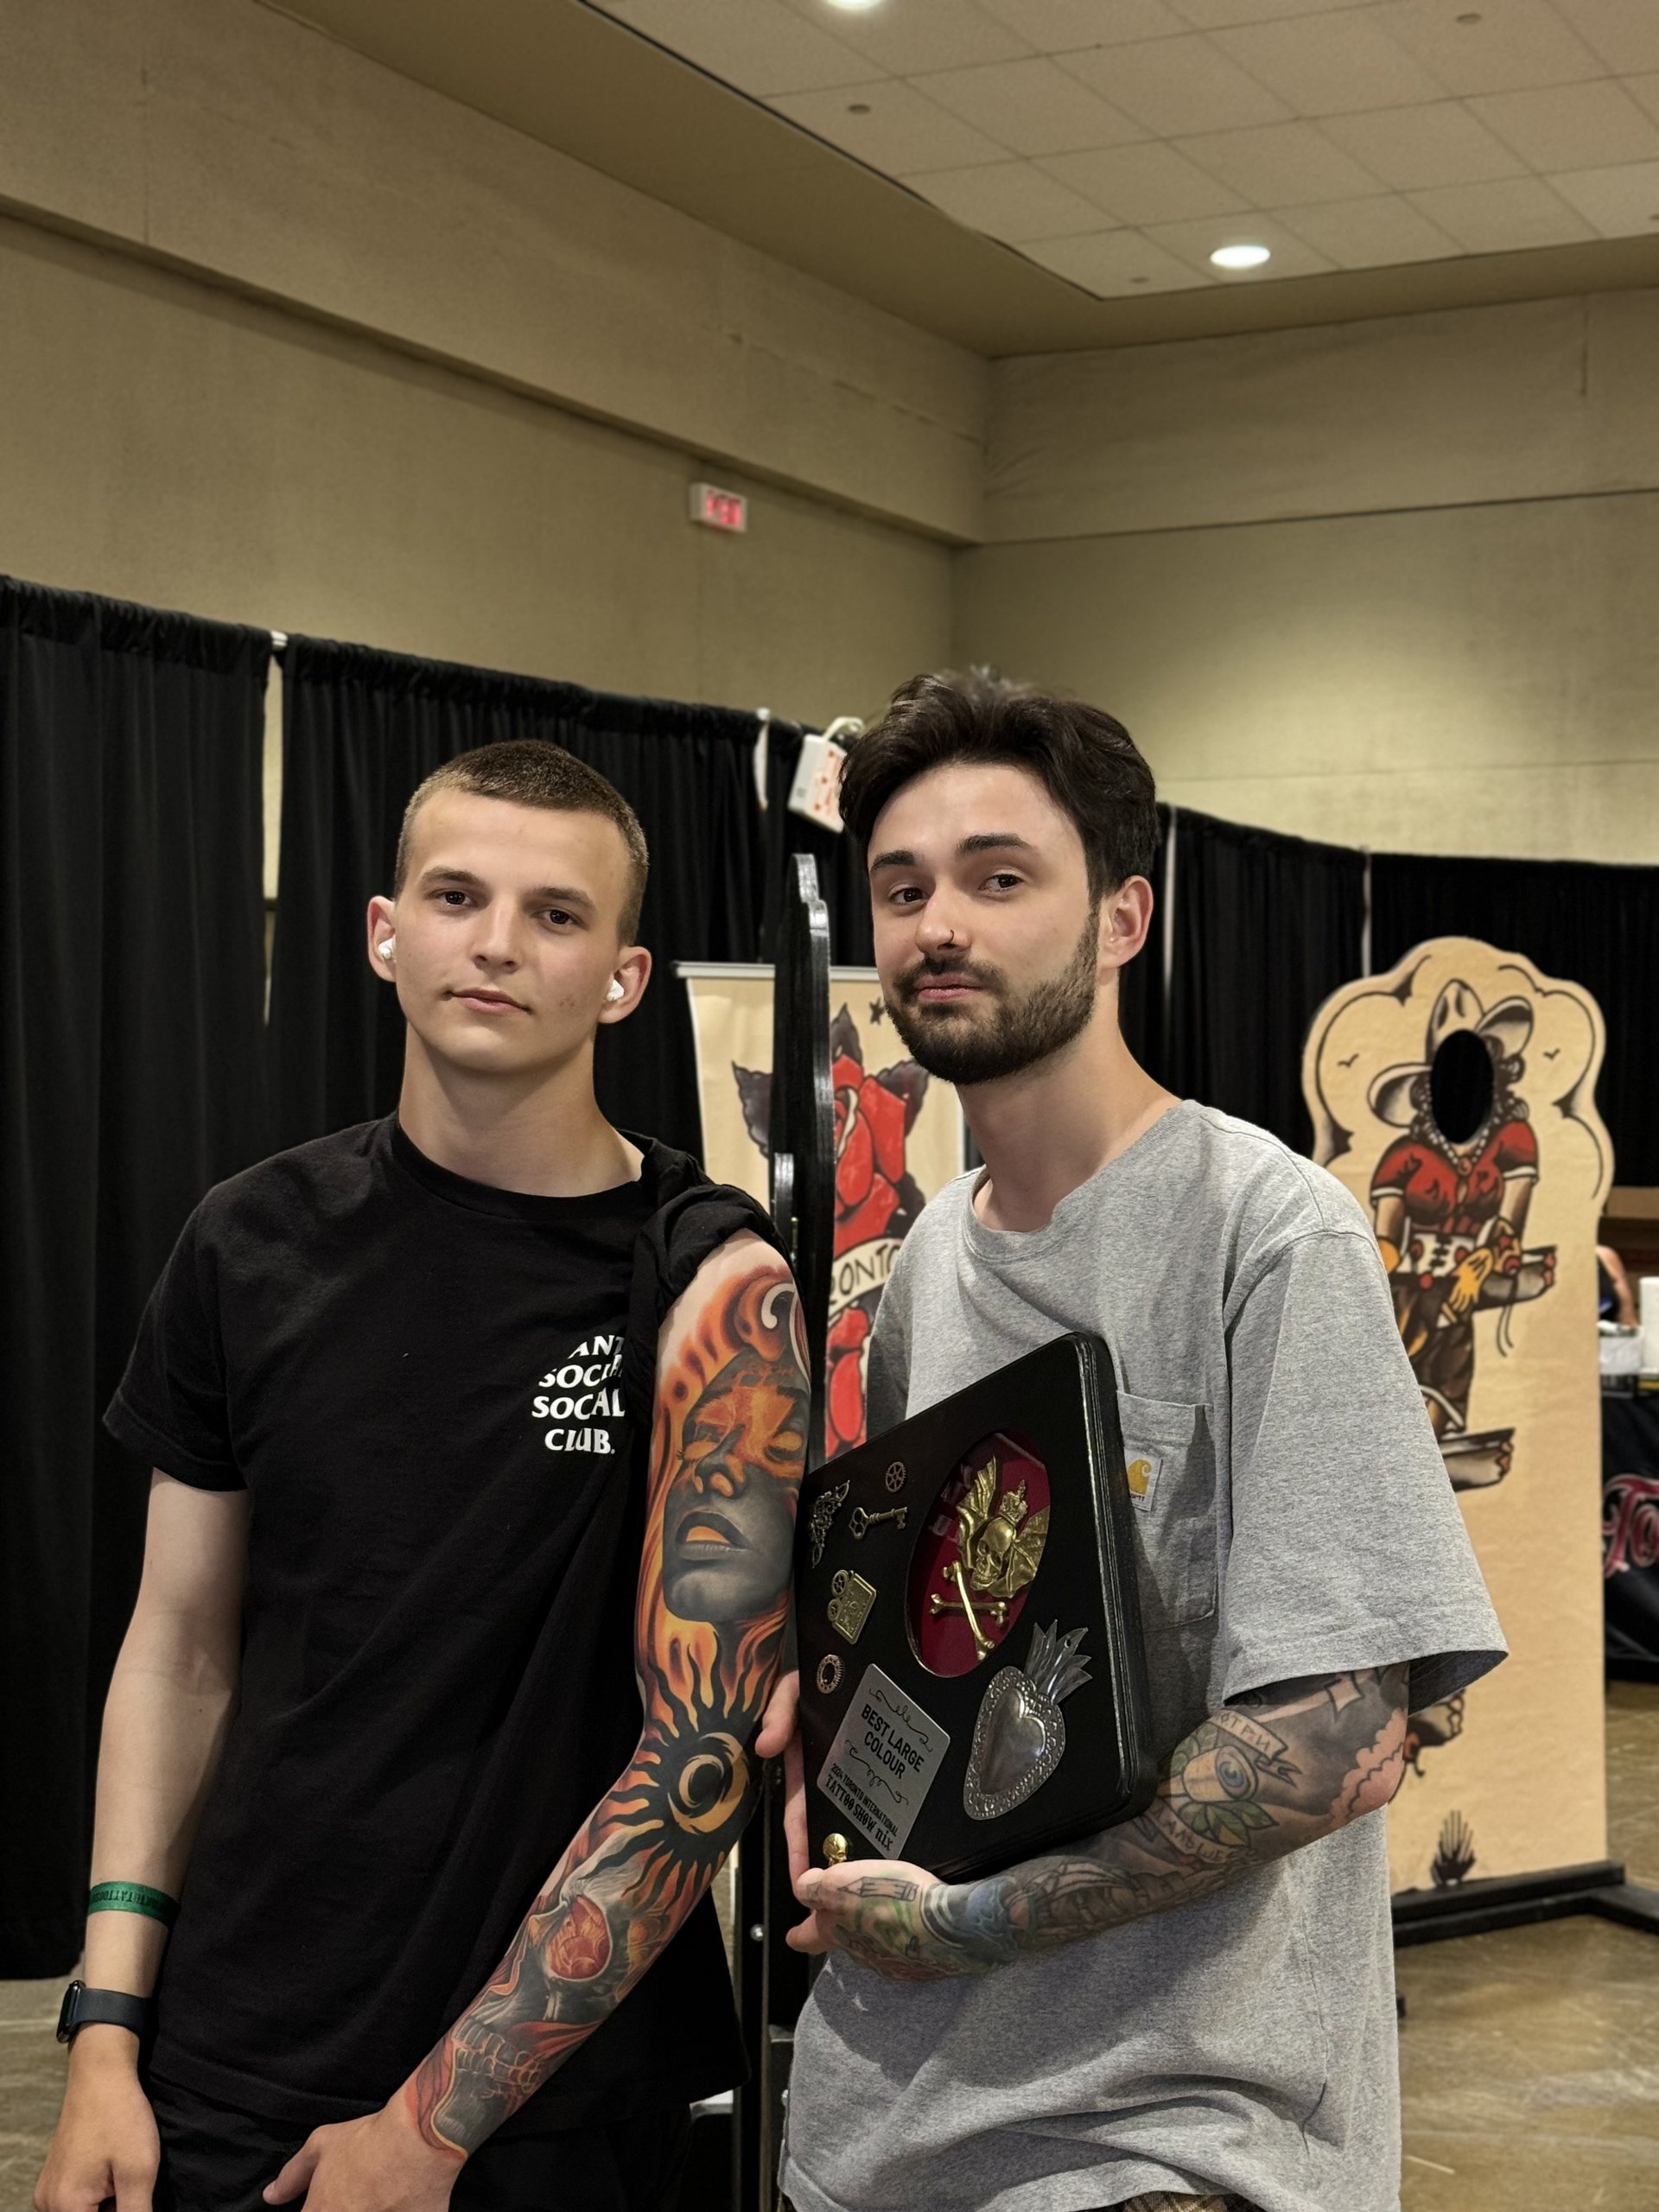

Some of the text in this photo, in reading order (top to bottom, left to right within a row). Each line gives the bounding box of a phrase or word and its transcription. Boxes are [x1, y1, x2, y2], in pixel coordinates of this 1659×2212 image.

[830, 1243, 900, 1304] ONTO
[544, 1427, 615, 1454] CLUB.
[861, 1703, 925, 1773] BEST LARGE
[864, 1731, 906, 1779] COLOUR
[824, 1774, 855, 1810] TATTOO
[852, 1803, 877, 1833] SHOW
[842, 1774, 865, 1802] TORONTO
[862, 1795, 898, 1837] INTERNATIONAL
